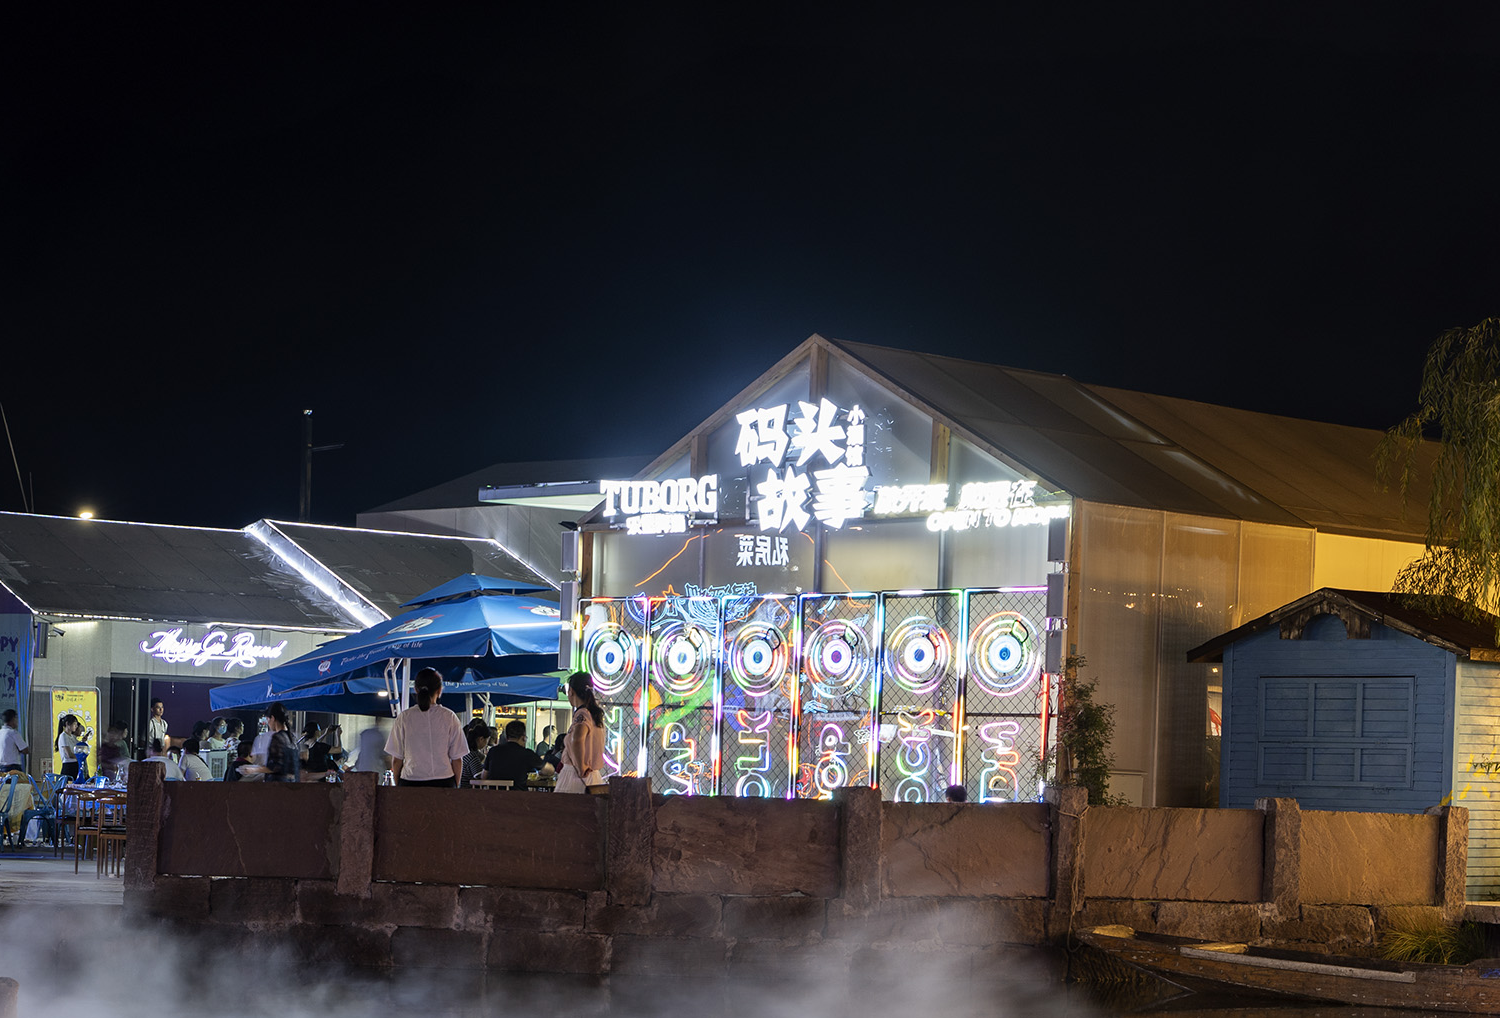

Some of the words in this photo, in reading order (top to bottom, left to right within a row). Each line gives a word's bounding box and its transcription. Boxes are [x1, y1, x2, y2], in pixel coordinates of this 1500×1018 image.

[735, 397, 846, 467] 码头
[600, 474, 718, 517] TUBORG
[756, 462, 872, 533] 故事
[736, 709, 773, 798] OLK
[815, 723, 851, 800] OP
[895, 708, 935, 803] OCK
